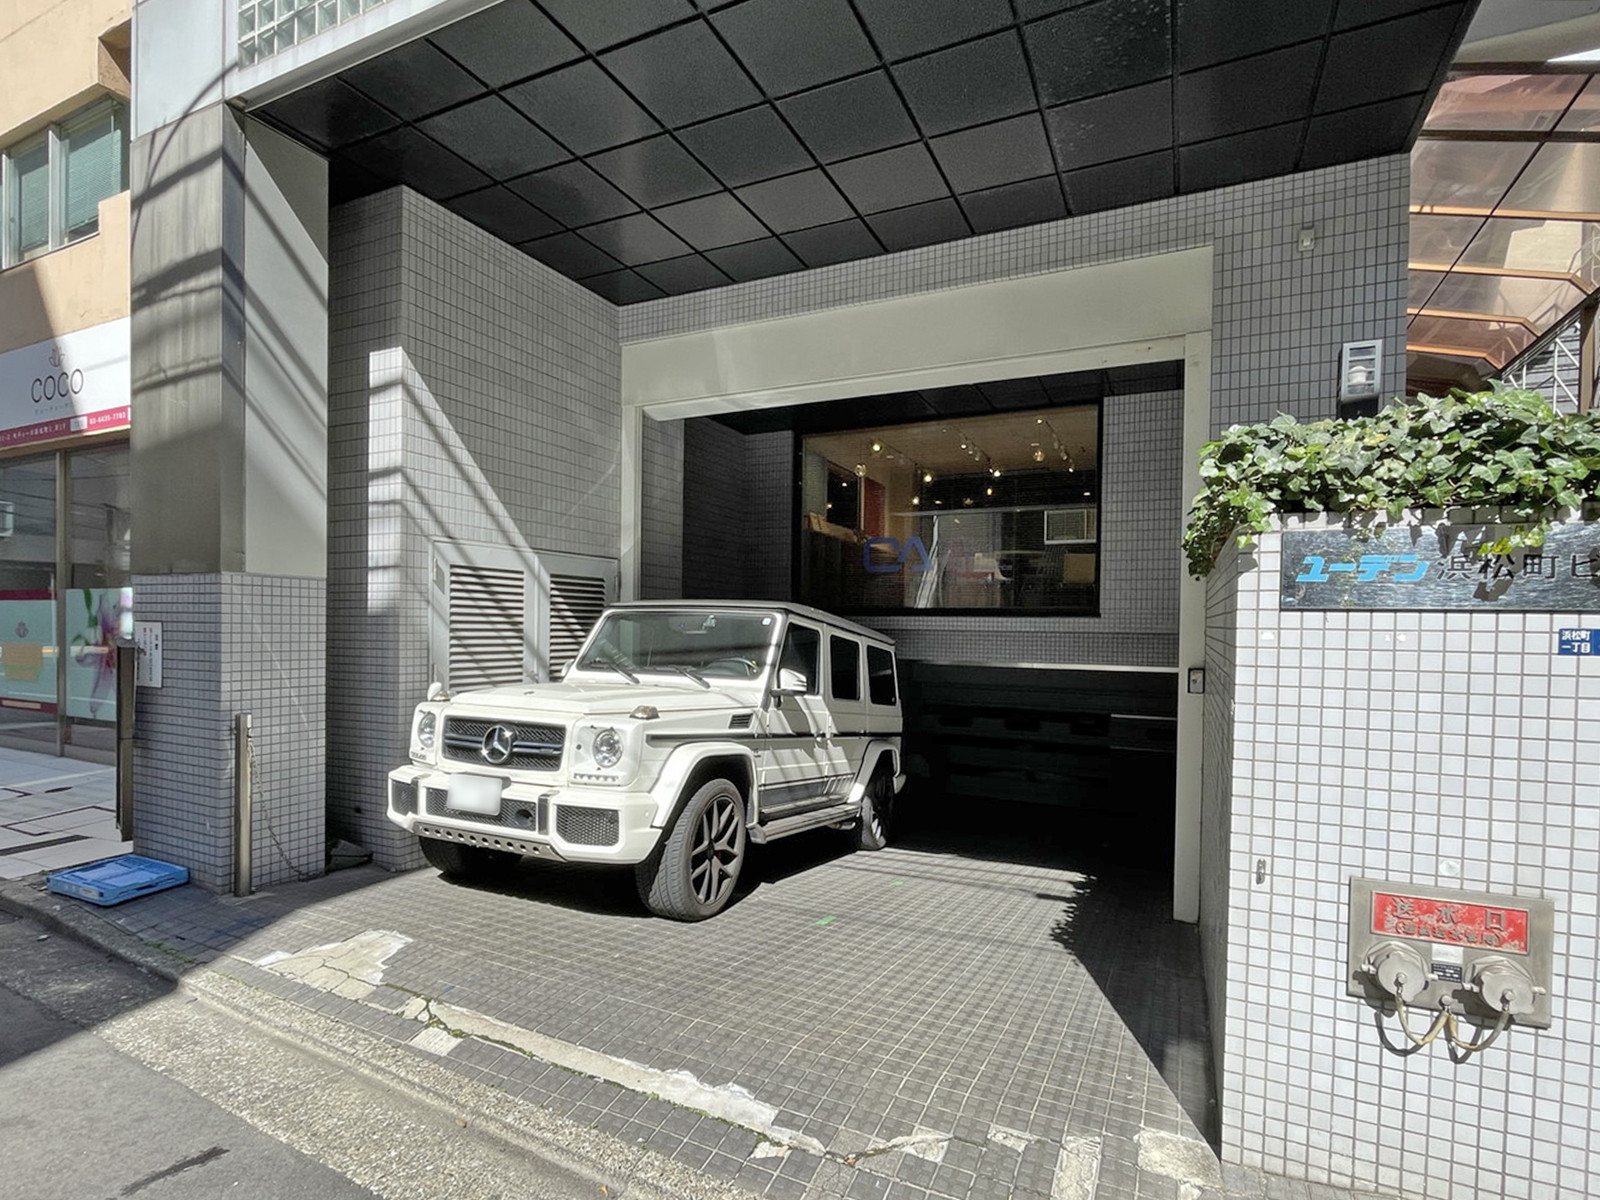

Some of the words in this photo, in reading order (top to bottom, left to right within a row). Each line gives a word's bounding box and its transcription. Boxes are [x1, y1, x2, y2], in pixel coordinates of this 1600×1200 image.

[31, 368, 84, 403] COCO
[1561, 630, 1591, 641] 浜松町
[1561, 642, 1591, 654] 一丁目
